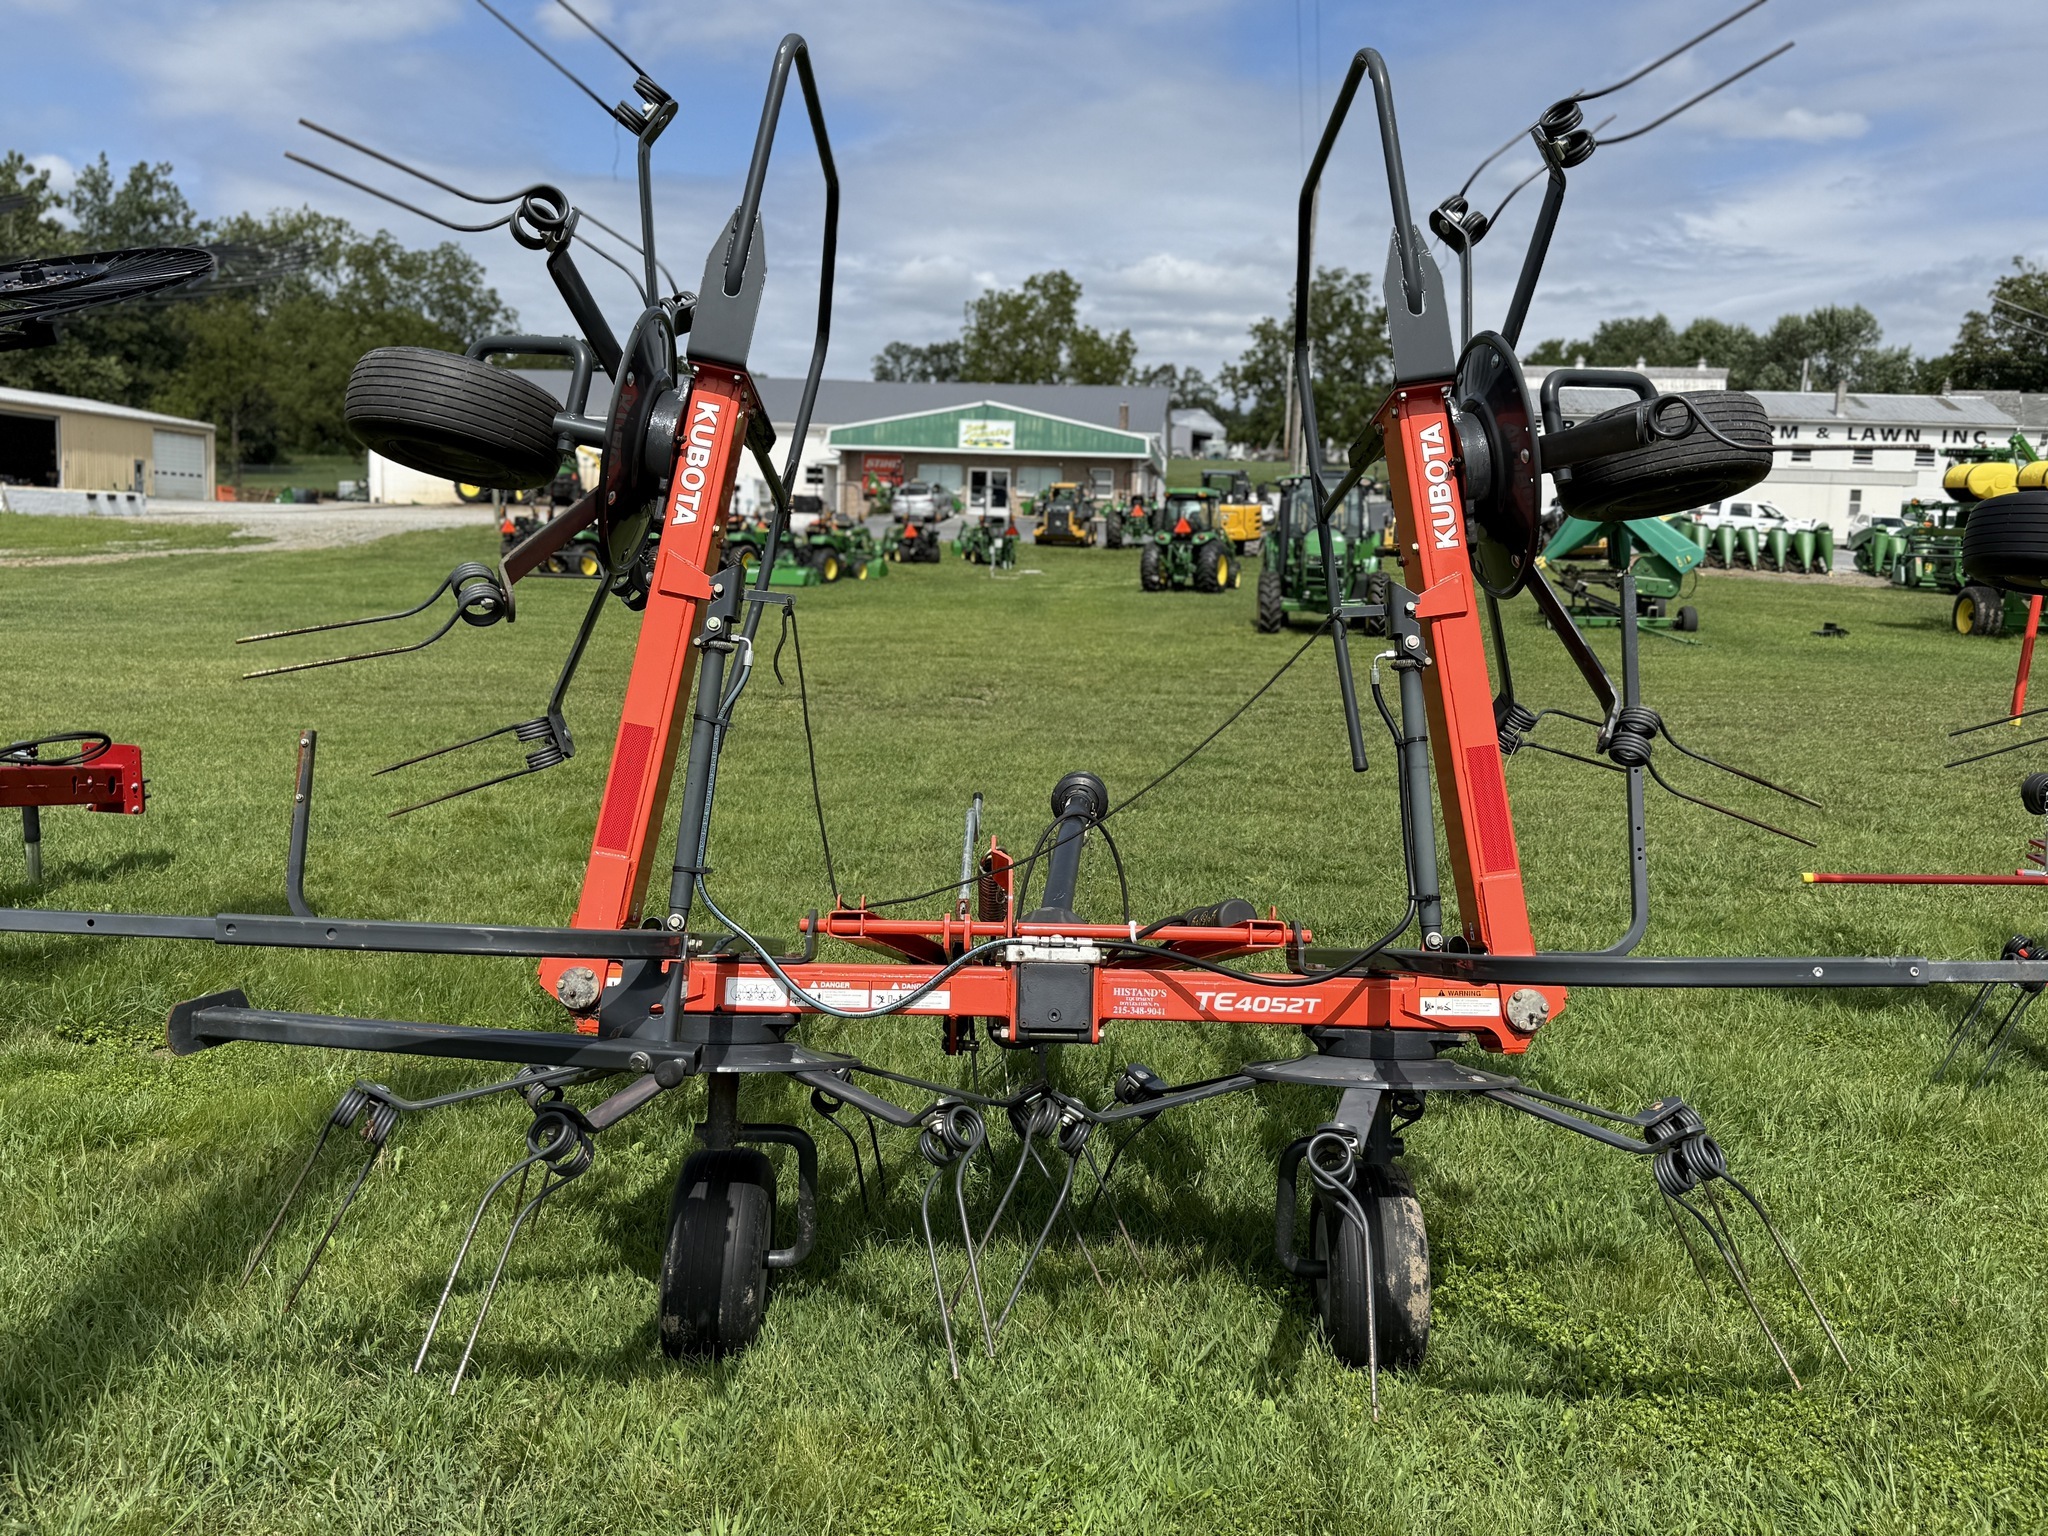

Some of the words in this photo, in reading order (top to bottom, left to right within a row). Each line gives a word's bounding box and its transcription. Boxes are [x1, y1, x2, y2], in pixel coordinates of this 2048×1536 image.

[1816, 427, 1830, 439] &
[1847, 427, 1921, 442] LAWN
[1942, 429, 1995, 445] INC.
[671, 401, 720, 526] KUBOTA
[1419, 420, 1460, 550] KUBOTA
[821, 981, 850, 989] DANGER
[1113, 987, 1167, 998] HISTAND'S
[1112, 1006, 1166, 1015] 215-348-9041
[1195, 991, 1322, 1014] TE4052T
